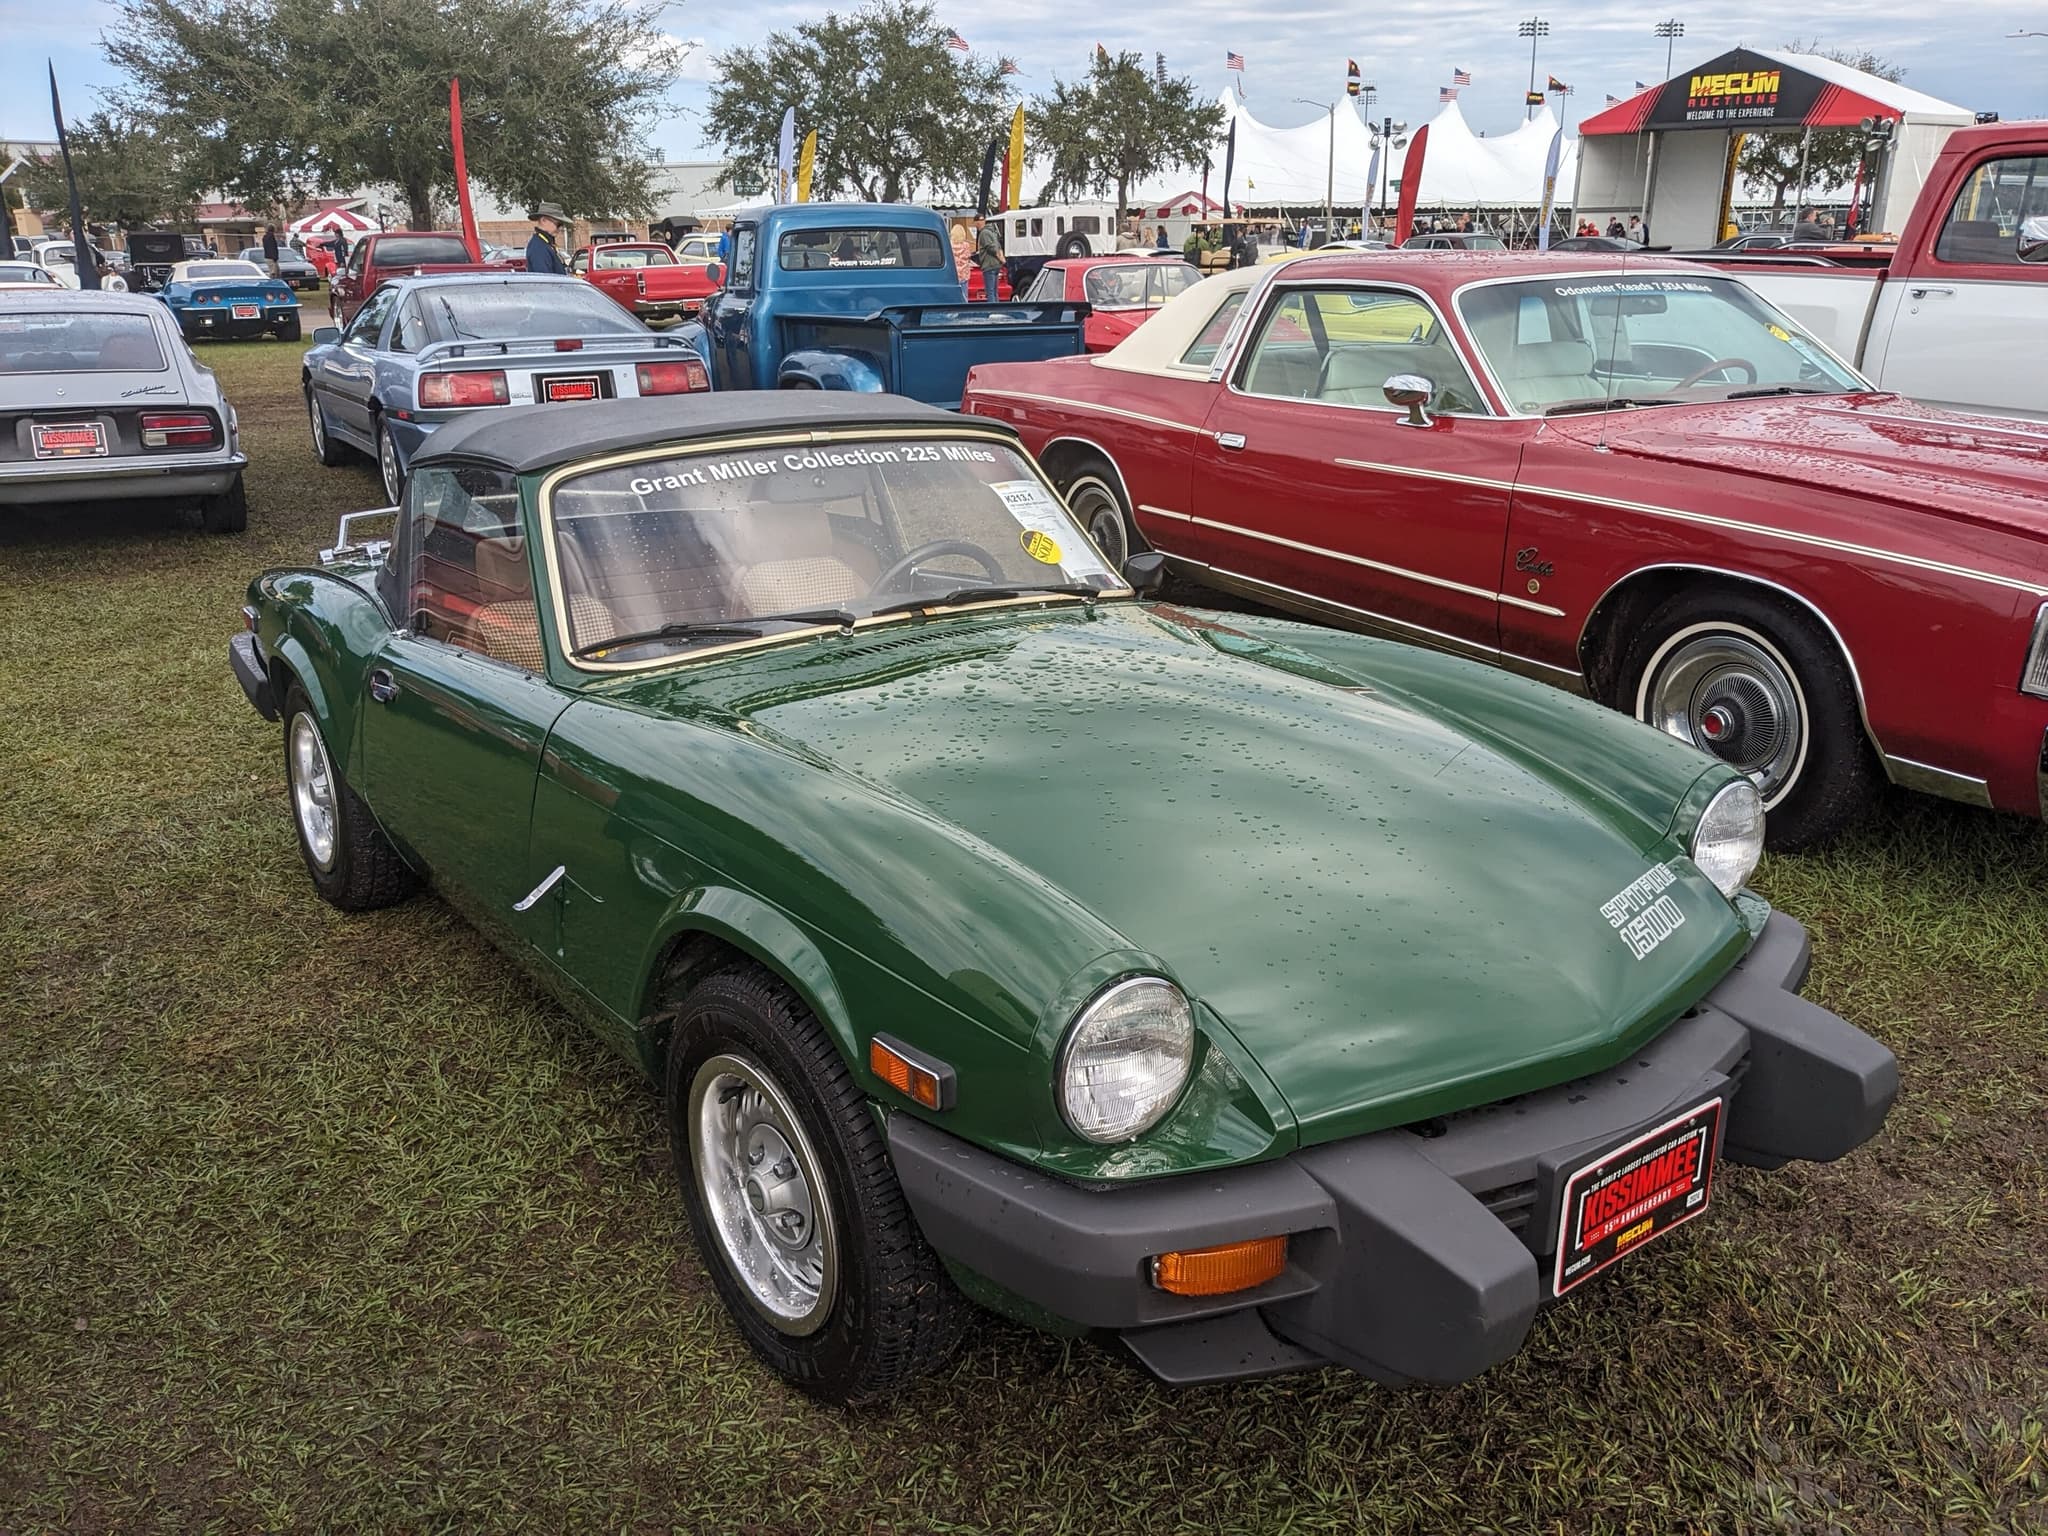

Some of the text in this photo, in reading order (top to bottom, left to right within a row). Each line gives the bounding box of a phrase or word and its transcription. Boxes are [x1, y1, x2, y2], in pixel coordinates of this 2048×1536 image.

[1689, 71, 1781, 97] MECUM
[1686, 106, 1775, 120] WELCOME TO THE EXPERIENCE
[1687, 94, 1778, 107] AUCTIONS
[1555, 284, 1615, 297] Odometer
[552, 384, 592, 395] KISSIMMEE
[43, 431, 96, 444] KISSIMMEE
[630, 446, 996, 496] Grant Miller Collection 225 Miles
[1004, 493, 1034, 504] K213.1
[1037, 536, 1054, 562] SOLD
[1600, 862, 1677, 928] SPITFIRE
[1619, 894, 1686, 961] 1500
[1600, 1168, 1621, 1187] WORLD'S
[1621, 1157, 1641, 1175] LARGEST
[1641, 1143, 1666, 1164] COLLECTOR
[1667, 1138, 1677, 1150] CAR
[1583, 1136, 1699, 1232] KISSIMMEE
[1620, 1186, 1672, 1225] ANNIVERSARY
[1616, 1215, 1653, 1248] MECUM
